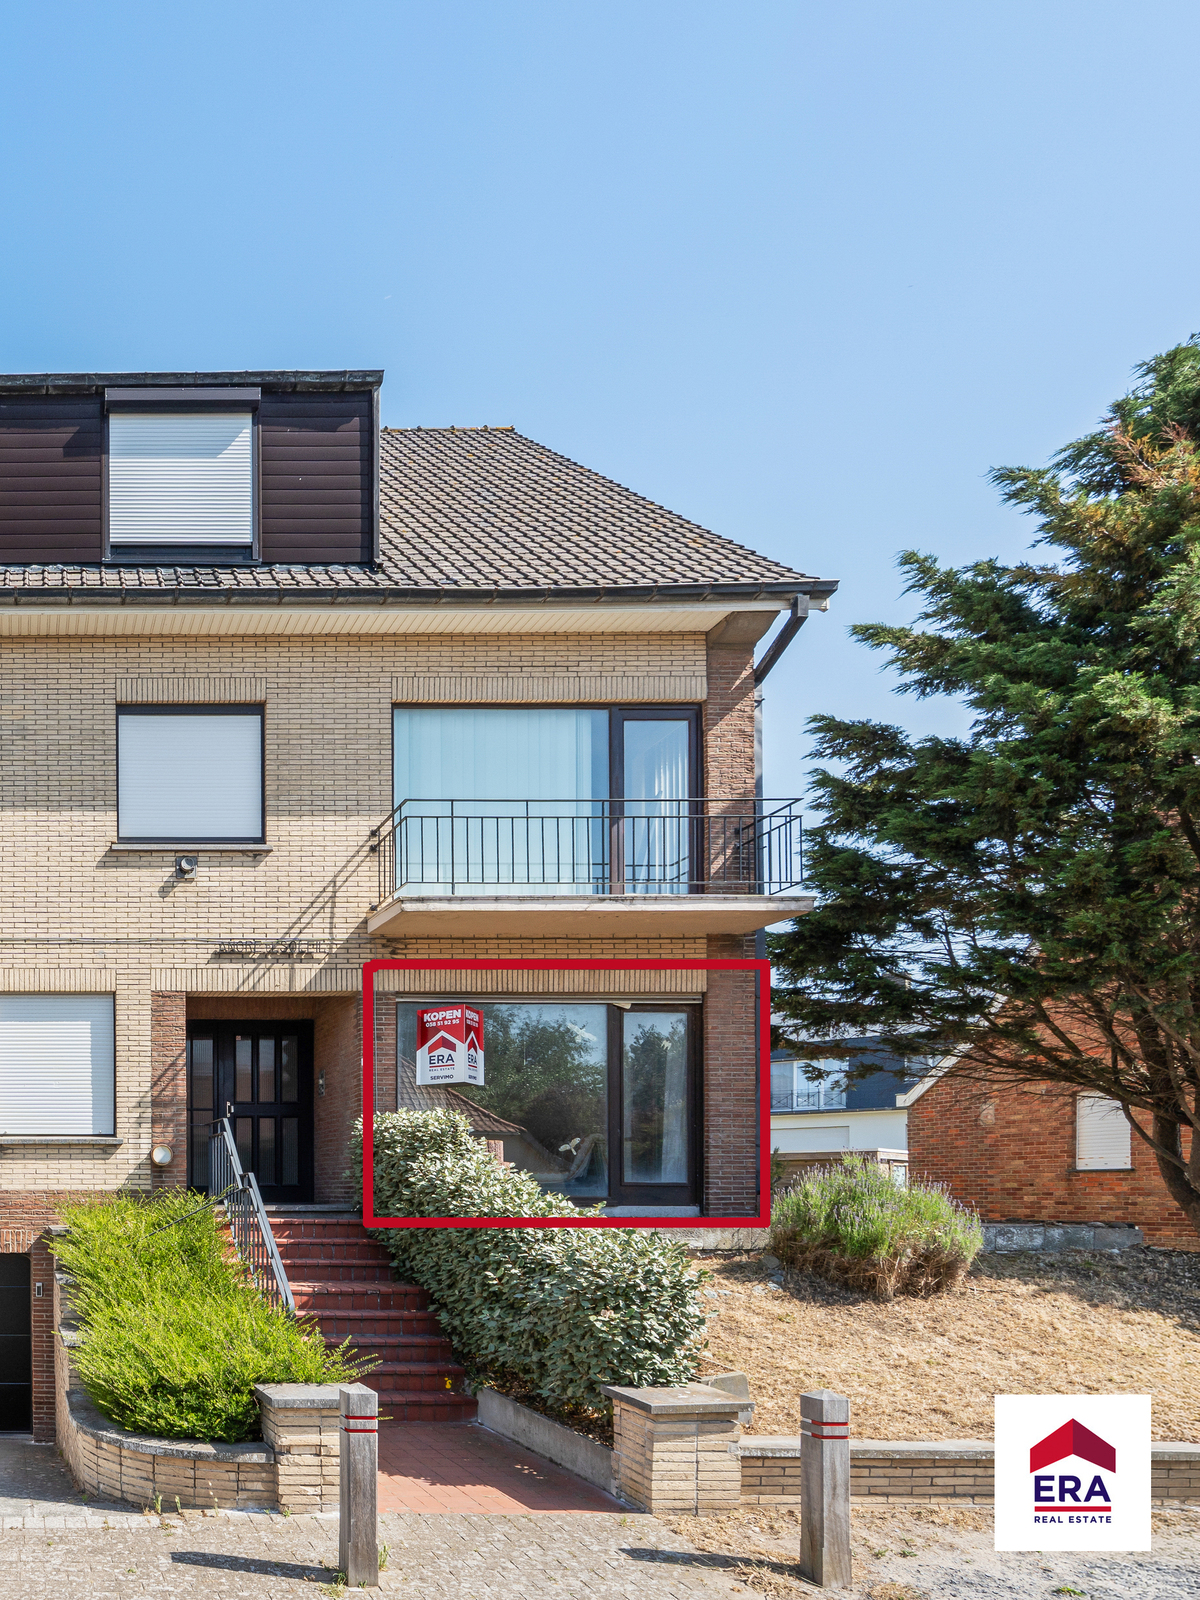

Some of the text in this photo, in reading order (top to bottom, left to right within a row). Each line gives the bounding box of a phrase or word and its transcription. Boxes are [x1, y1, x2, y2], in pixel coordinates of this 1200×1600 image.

[424, 1009, 461, 1022] KOPEN
[466, 1009, 479, 1022] KOPEN
[429, 1053, 455, 1065] ERA
[468, 1053, 477, 1065] ERA
